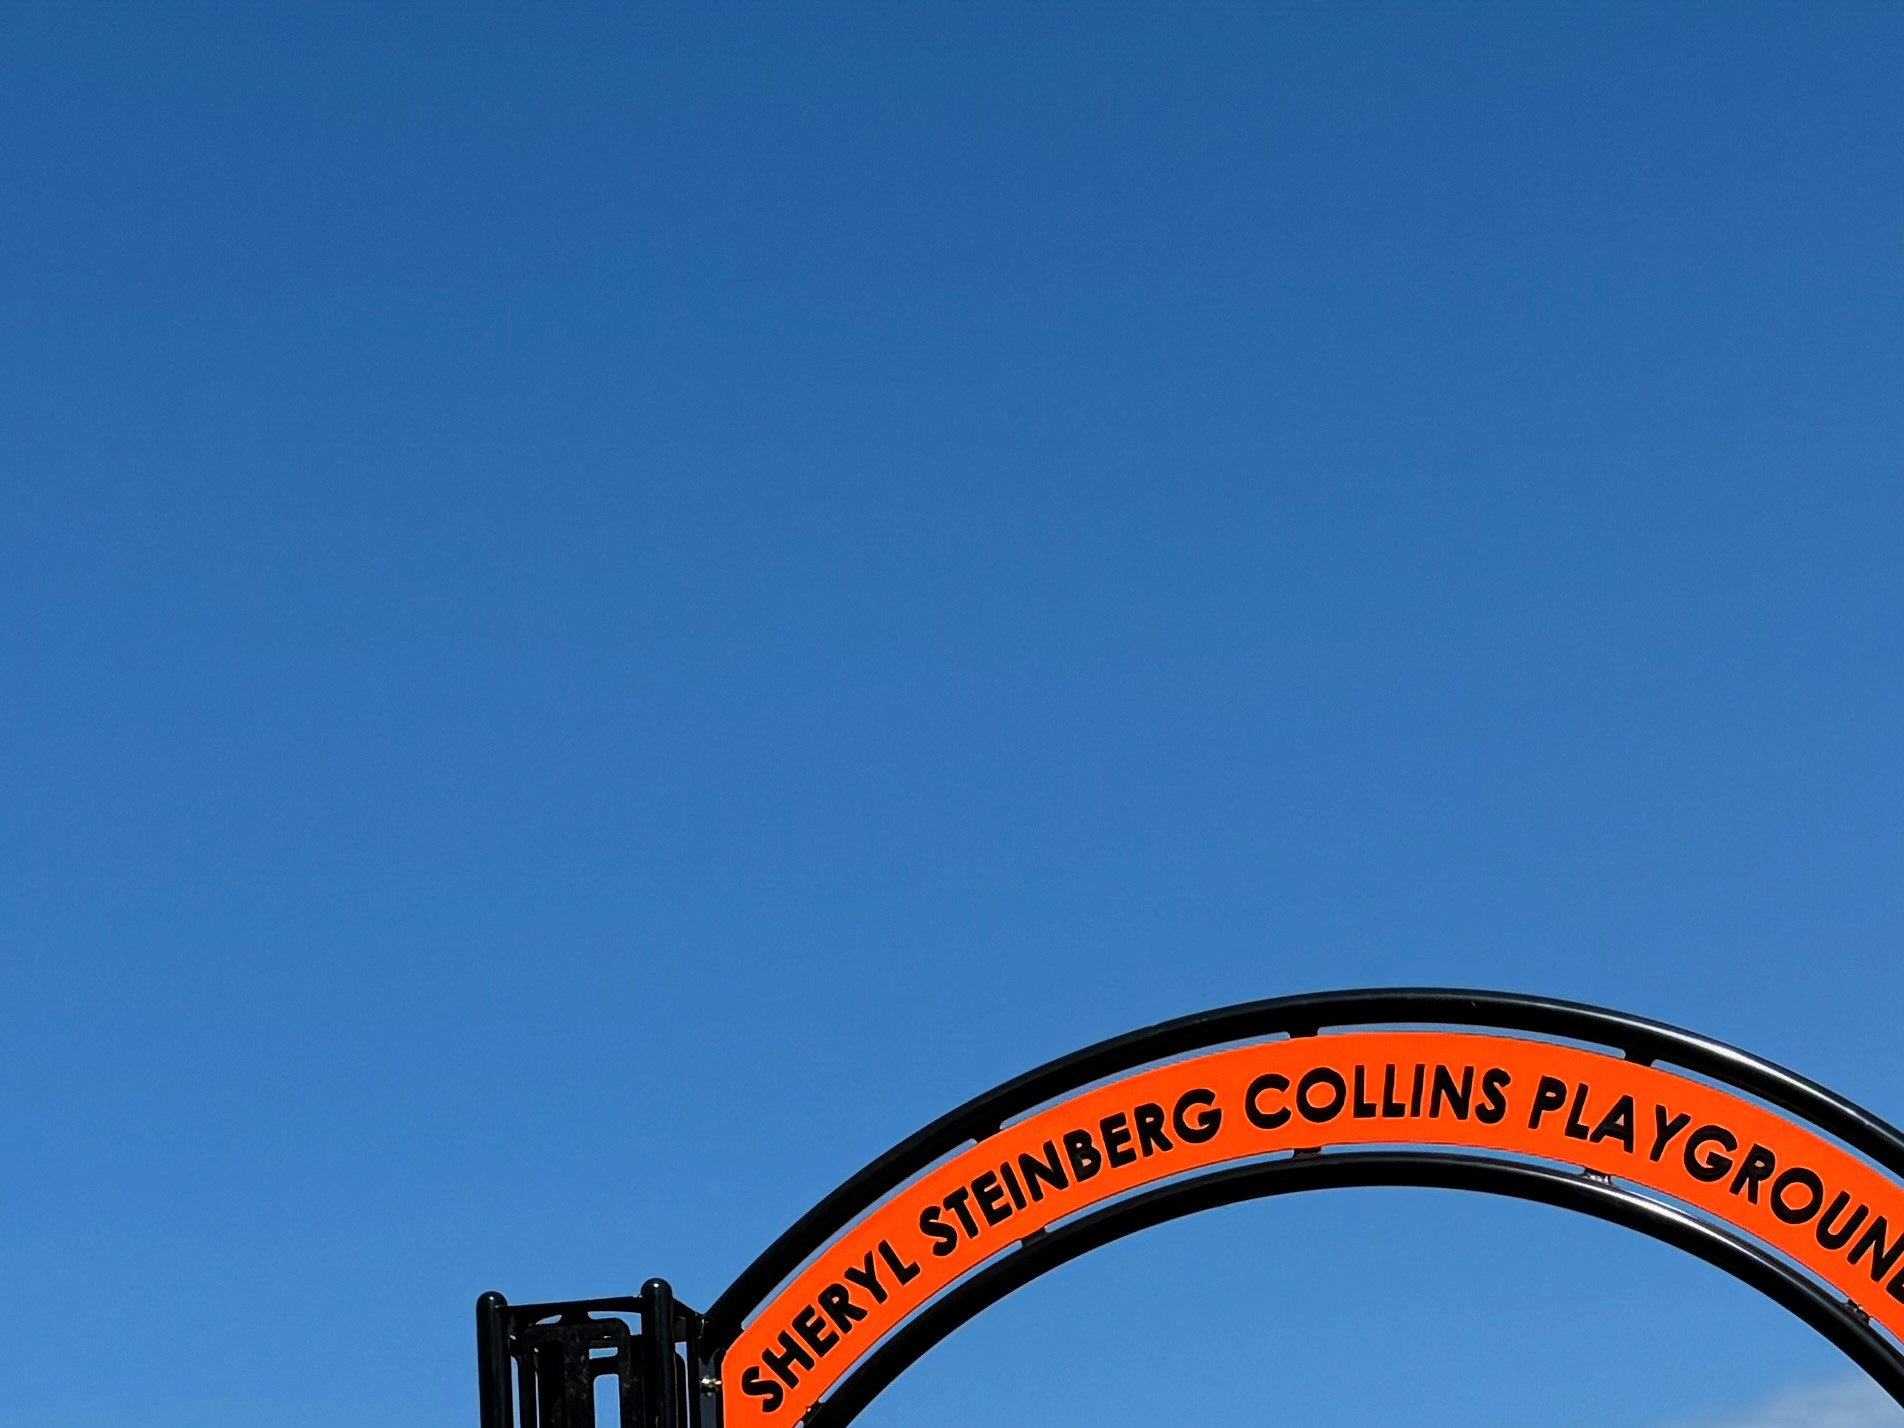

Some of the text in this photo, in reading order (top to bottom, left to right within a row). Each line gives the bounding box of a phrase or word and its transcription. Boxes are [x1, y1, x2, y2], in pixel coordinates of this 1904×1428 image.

[741, 1239, 921, 1413] SHERYL
[919, 1088, 1222, 1257] STEINBERG
[1244, 1063, 1512, 1130] COLLINS
